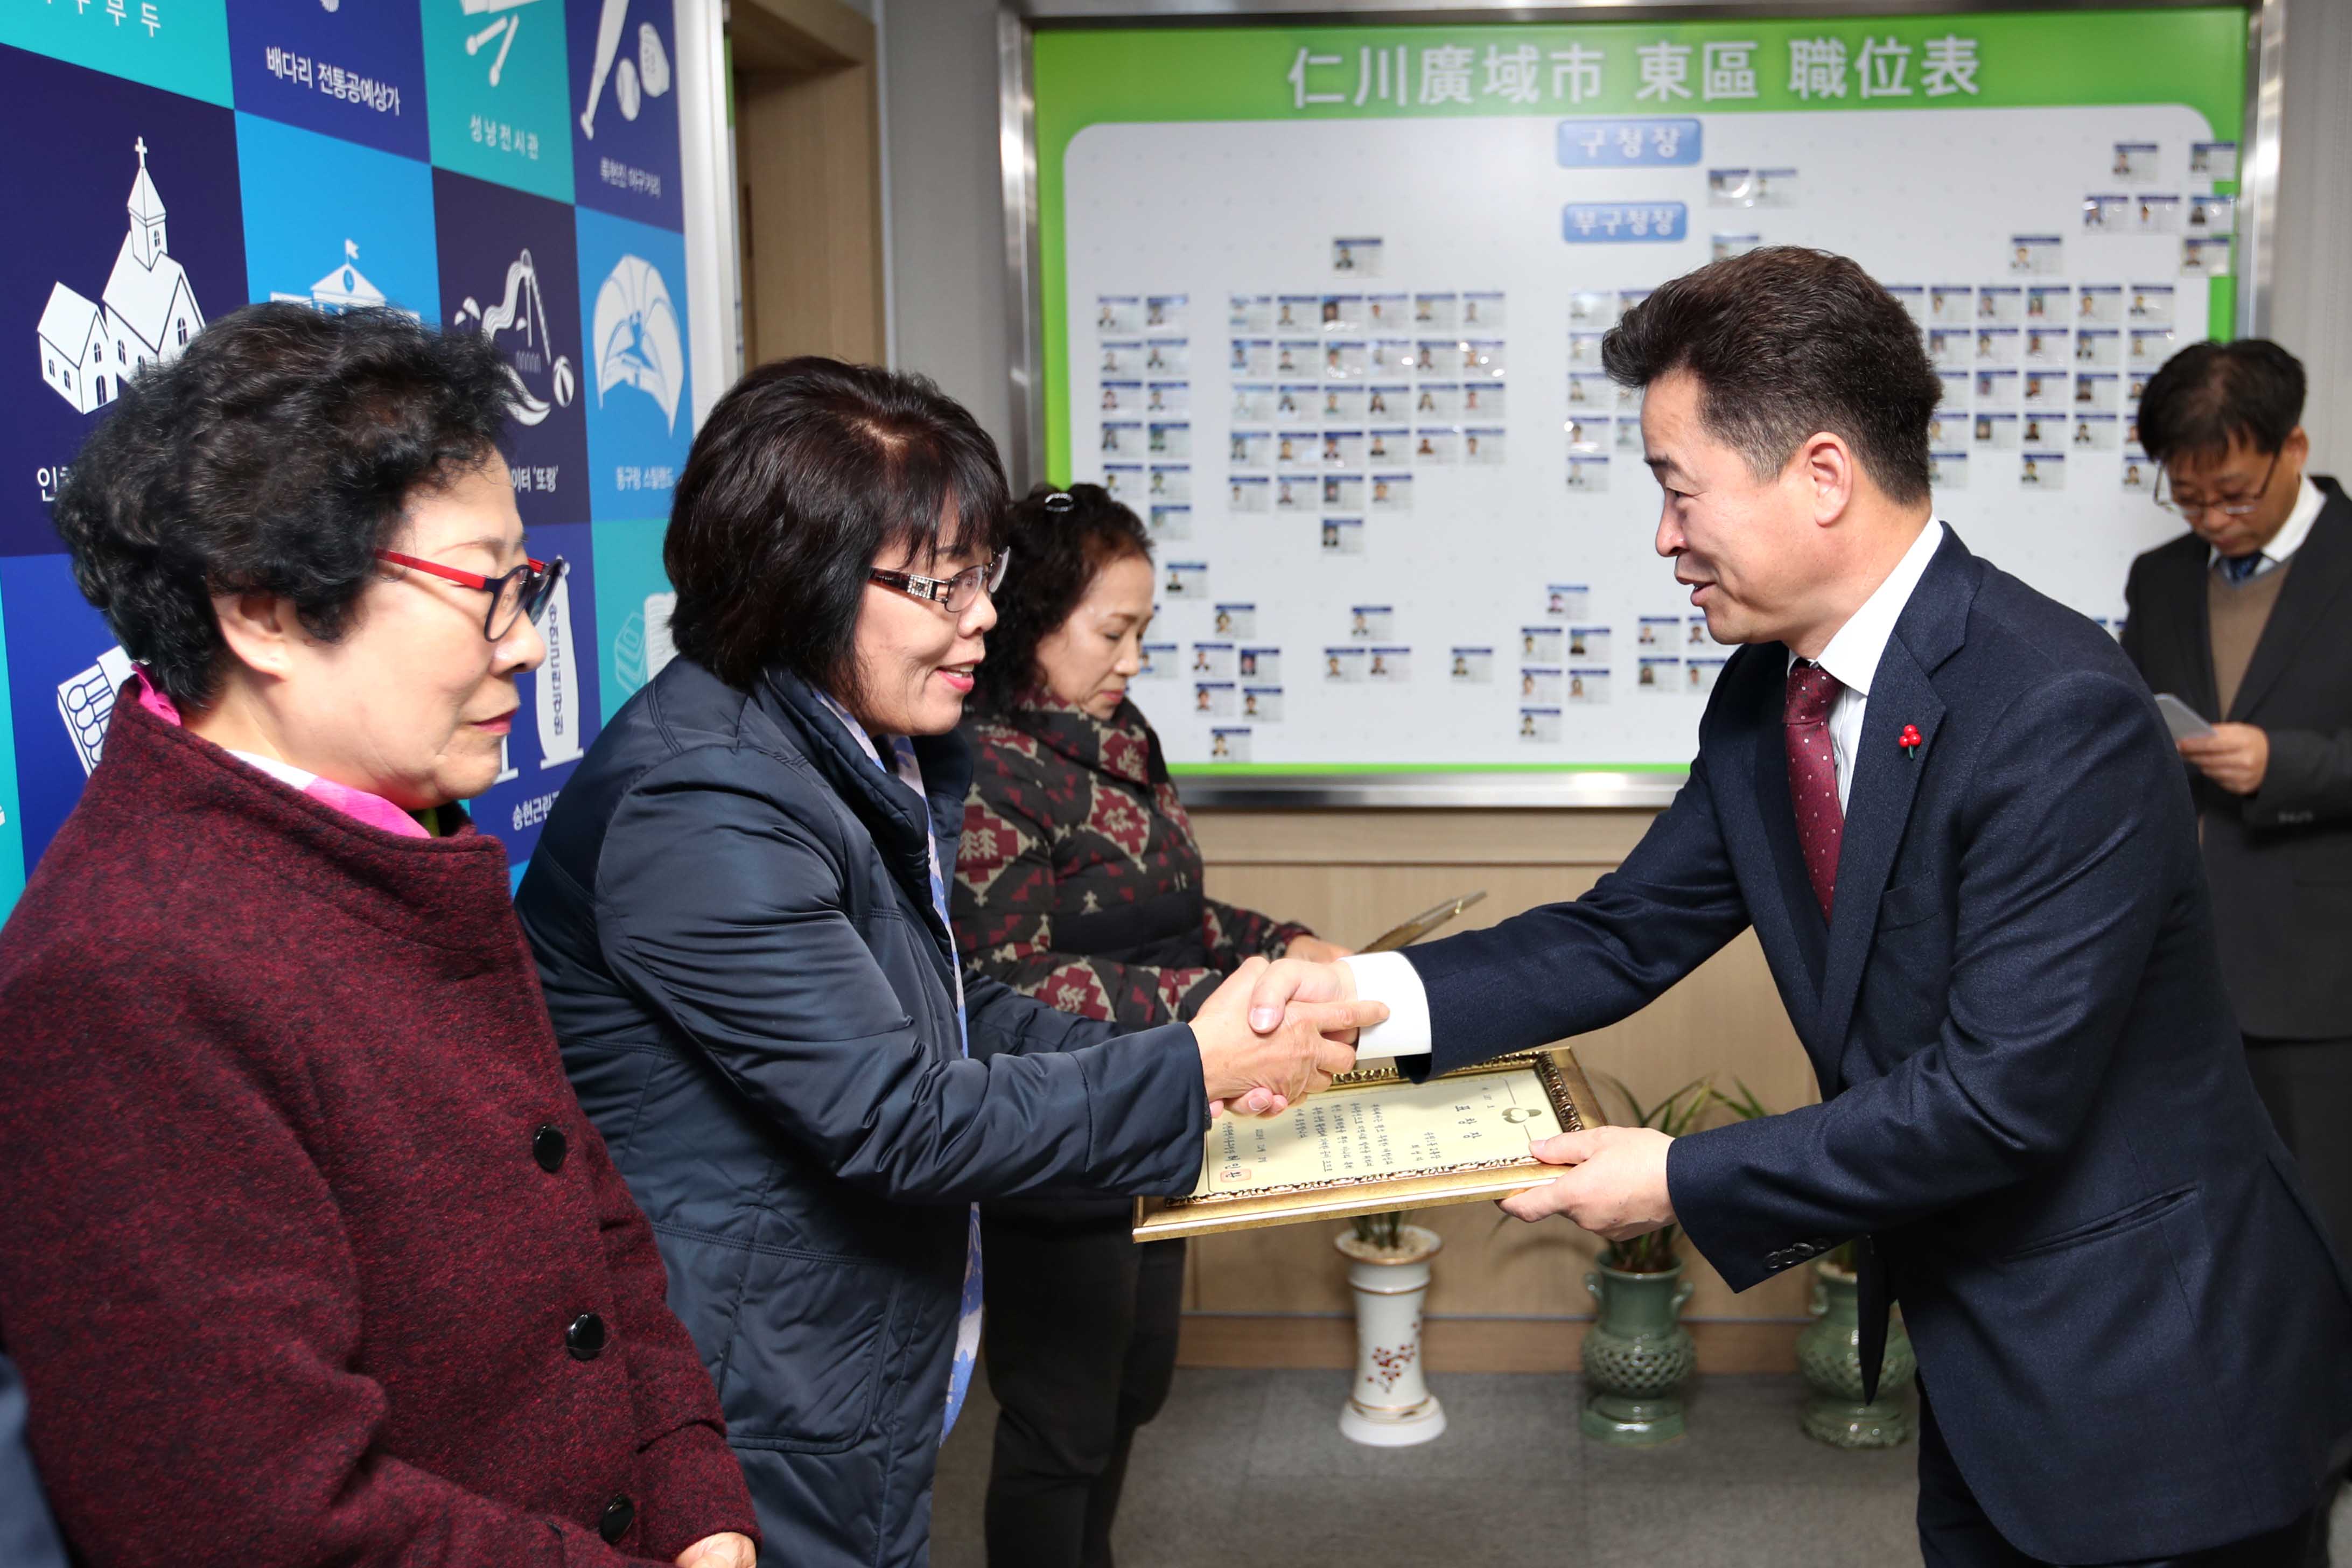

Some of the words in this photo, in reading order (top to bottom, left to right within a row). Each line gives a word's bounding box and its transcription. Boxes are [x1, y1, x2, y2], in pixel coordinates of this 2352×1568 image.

[266, 46, 313, 89] 배다리
[318, 62, 401, 117] 전통공예상가
[1287, 43, 1604, 108] 仁川廣域市
[1635, 41, 1759, 102] 東區
[1788, 35, 1979, 100] 職位表
[1579, 125, 1681, 158] 구청장
[512, 466, 531, 493] 이터
